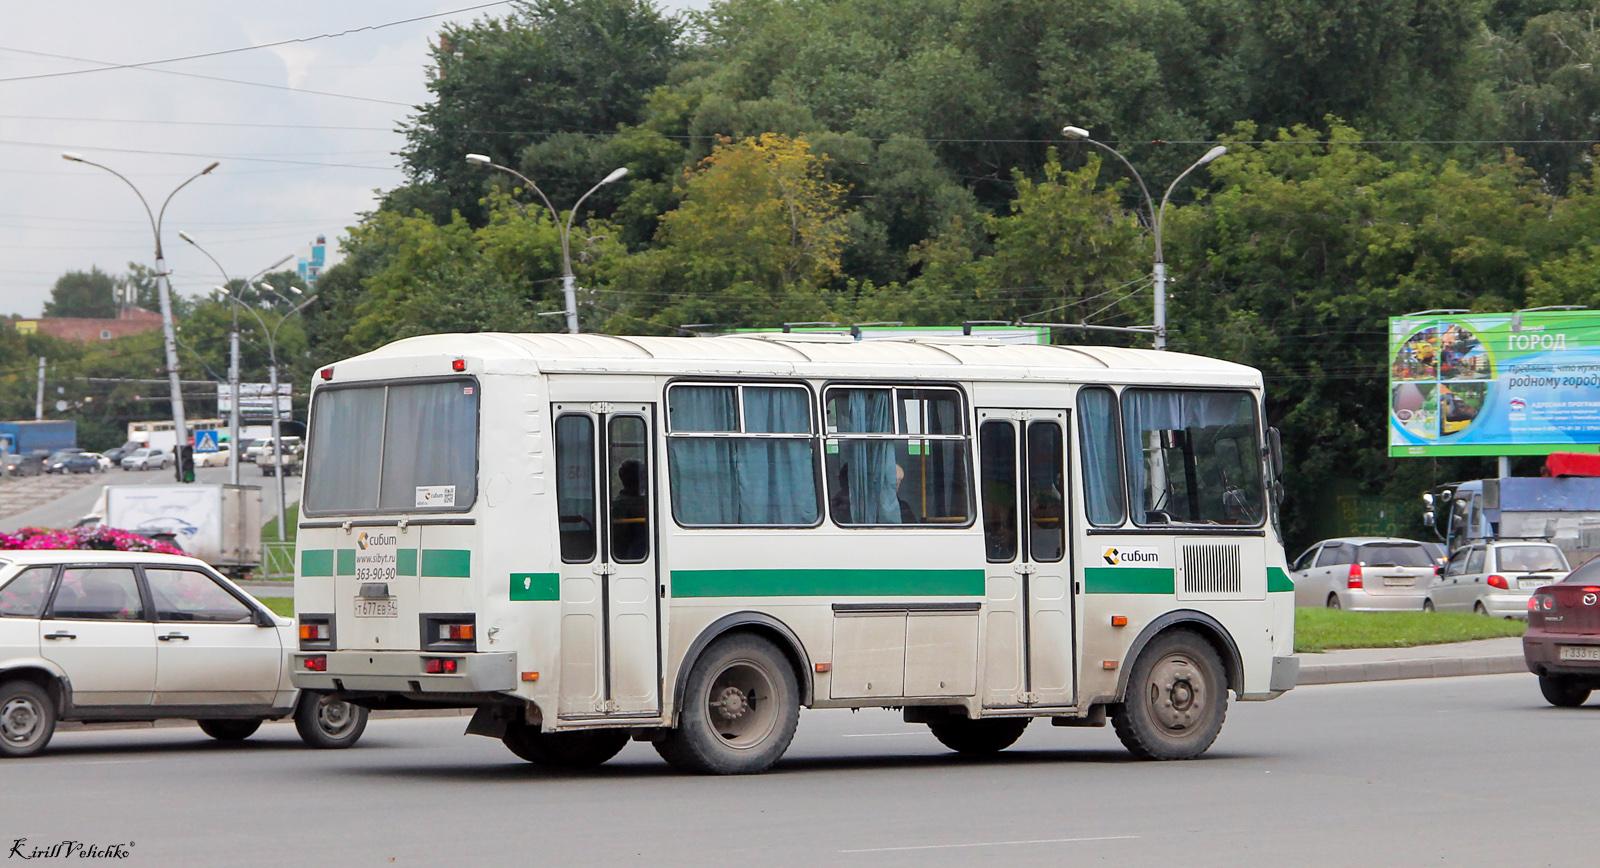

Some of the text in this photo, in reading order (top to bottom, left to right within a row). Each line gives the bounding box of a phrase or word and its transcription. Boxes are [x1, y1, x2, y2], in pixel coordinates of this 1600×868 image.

[1508, 333, 1566, 351] ГОРОД
[1509, 374, 1561, 389] родному
[369, 533, 397, 546] сибит
[356, 552, 396, 565] www.sibyt.ru
[1120, 549, 1159, 562] сибит
[356, 567, 396, 580] 363-90-90
